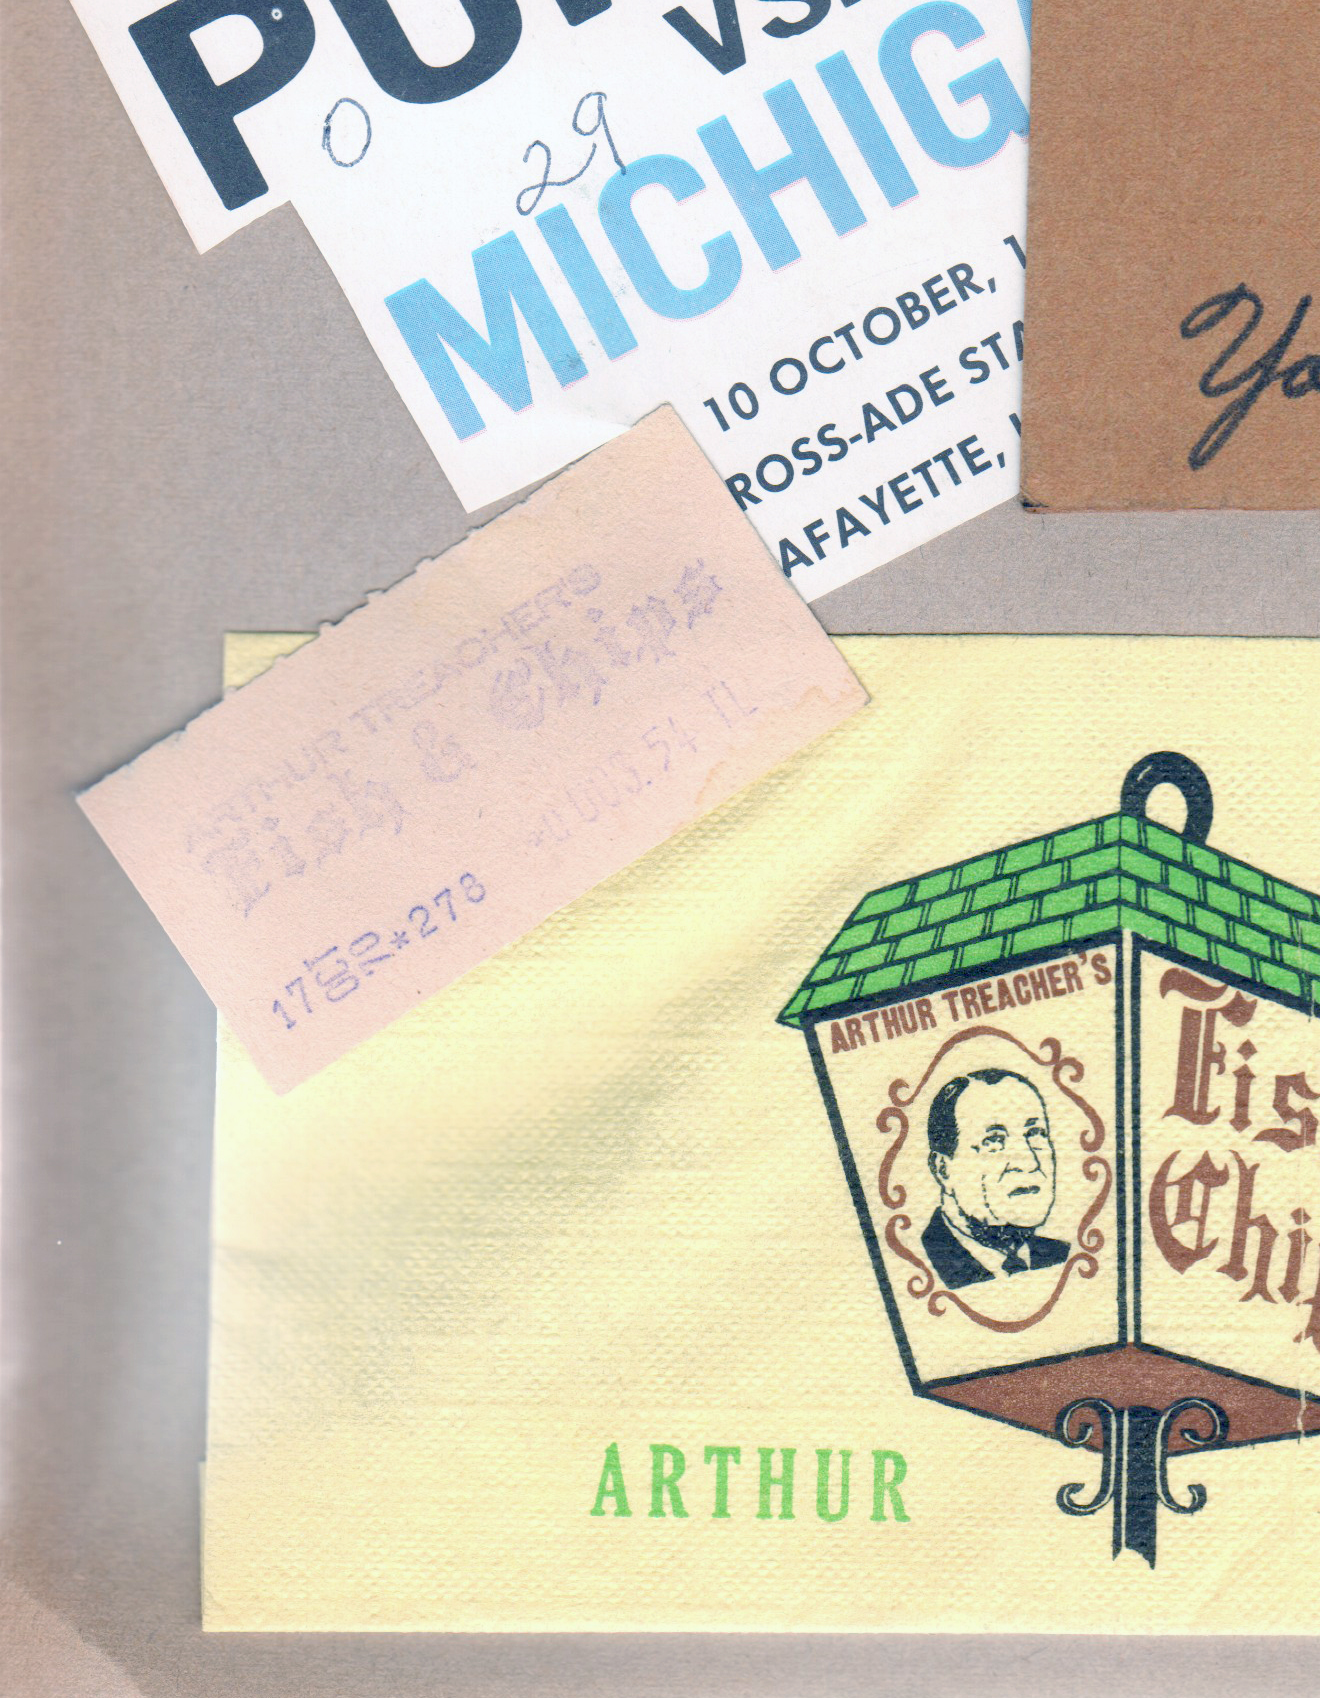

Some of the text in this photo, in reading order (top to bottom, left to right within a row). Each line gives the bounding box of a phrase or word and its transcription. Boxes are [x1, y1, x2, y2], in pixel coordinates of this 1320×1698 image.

[515, 90, 628, 217] 29
[703, 382, 760, 433] 10
[769, 262, 998, 396] OCTOBER,
[725, 365, 956, 512] ROSS-ADE
[777, 434, 1008, 578] AFAYETTE,
[830, 954, 1111, 1054] ARTHUR TREACHER'S
[589, 1442, 911, 1523] ARTHUR
